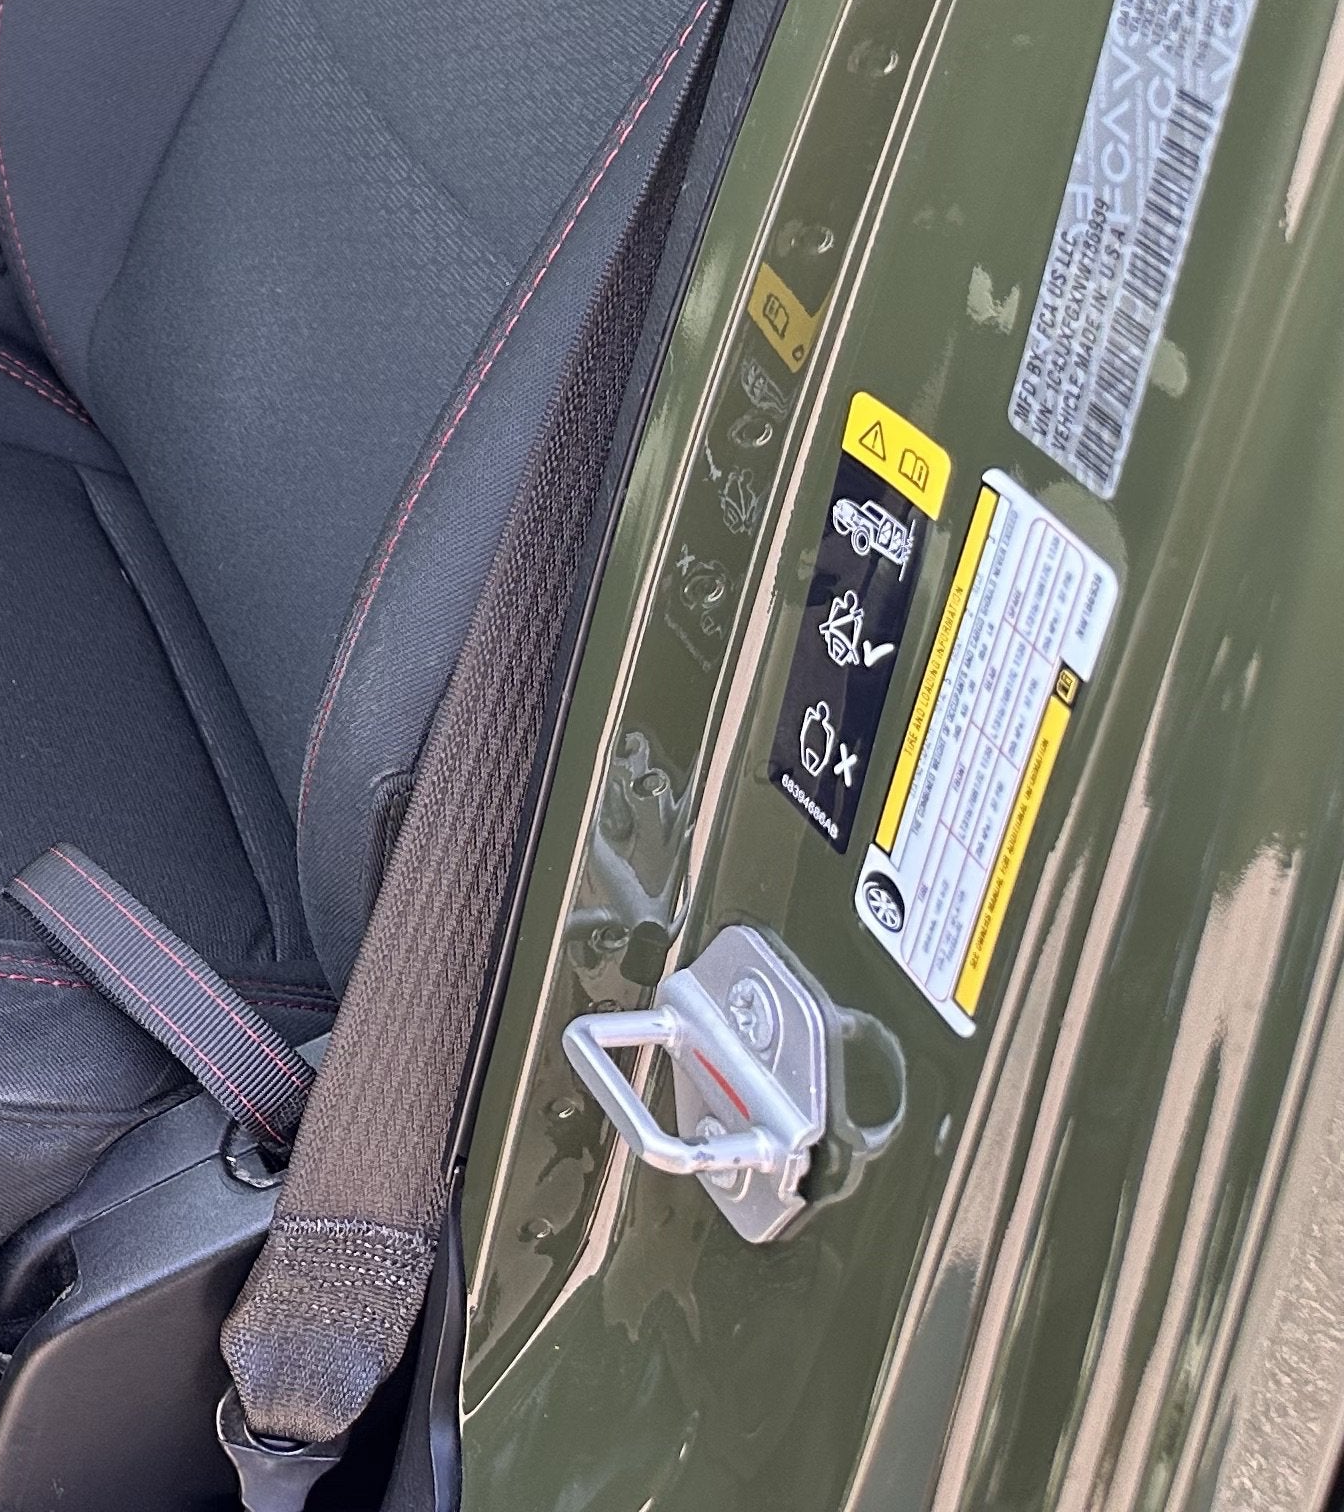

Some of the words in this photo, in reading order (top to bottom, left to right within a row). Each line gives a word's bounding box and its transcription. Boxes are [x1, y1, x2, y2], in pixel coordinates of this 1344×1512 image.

[1047, 269, 1067, 298] US
[1055, 230, 1077, 269] LLC
[1036, 302, 1058, 340] FCA
[1046, 198, 1108, 393] 1C4JJXFGXNW186939
[1014, 379, 1037, 423] MFD
[1052, 375, 1084, 451] VEHICLE
[1074, 315, 1100, 374] MADE
[904, 732, 918, 756] TIRE
[921, 660, 940, 707] LOADING
[936, 585, 963, 659] INFORMATION
[945, 670, 967, 722] OCCUPANTS
[967, 617, 985, 649] CARGO
